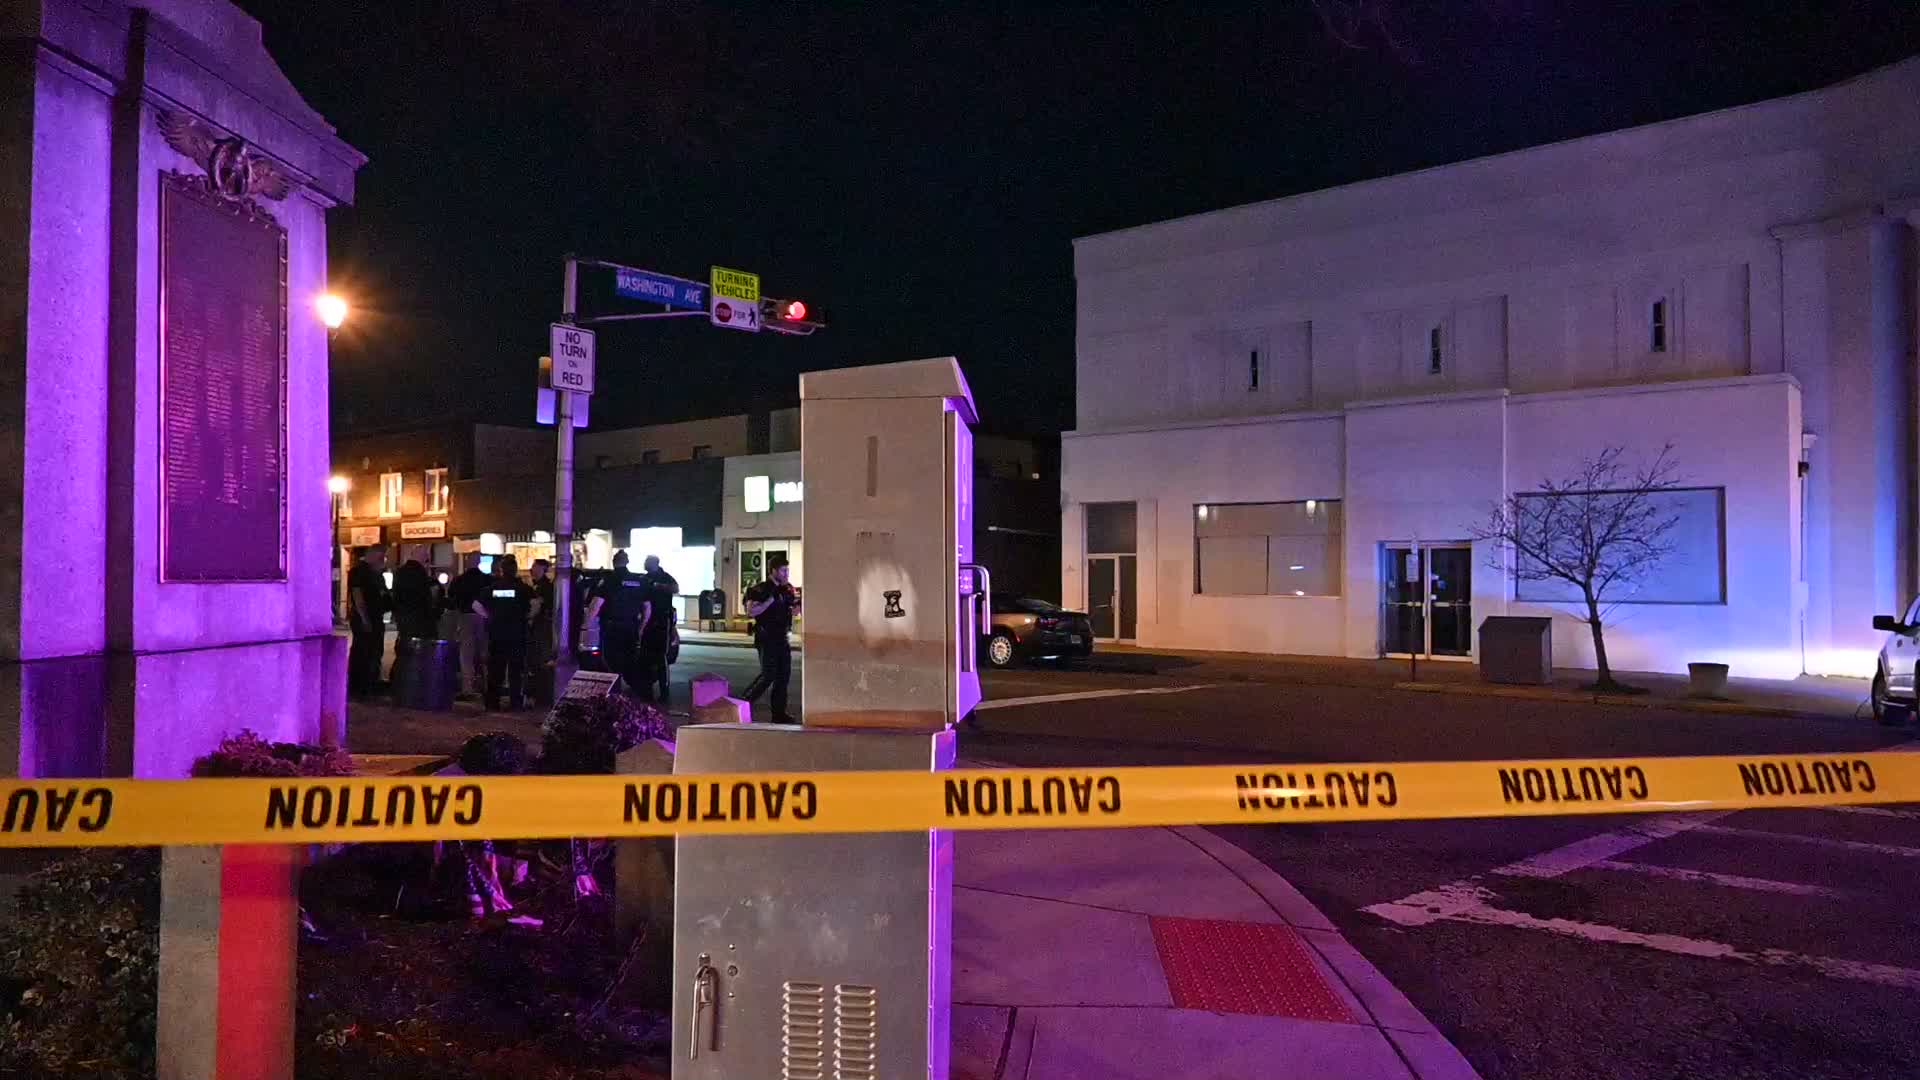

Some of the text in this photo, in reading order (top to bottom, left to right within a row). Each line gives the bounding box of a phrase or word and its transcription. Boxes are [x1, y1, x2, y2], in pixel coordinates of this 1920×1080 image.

[616, 275, 702, 305] WASHINGTON AVE
[716, 282, 757, 301] VEHICLES
[717, 271, 756, 288] TURNING
[560, 343, 587, 360] TURN
[565, 331, 581, 345] NO
[562, 371, 584, 386] RED
[568, 360, 578, 369] ON
[1236, 772, 1397, 809] CAUTION
[1499, 766, 1649, 803] CAUTION
[1738, 760, 1876, 796] CAUTION
[266, 785, 482, 828] CAUTION
[624, 782, 816, 822] CAUTION
[945, 777, 1120, 816] CAUTION
